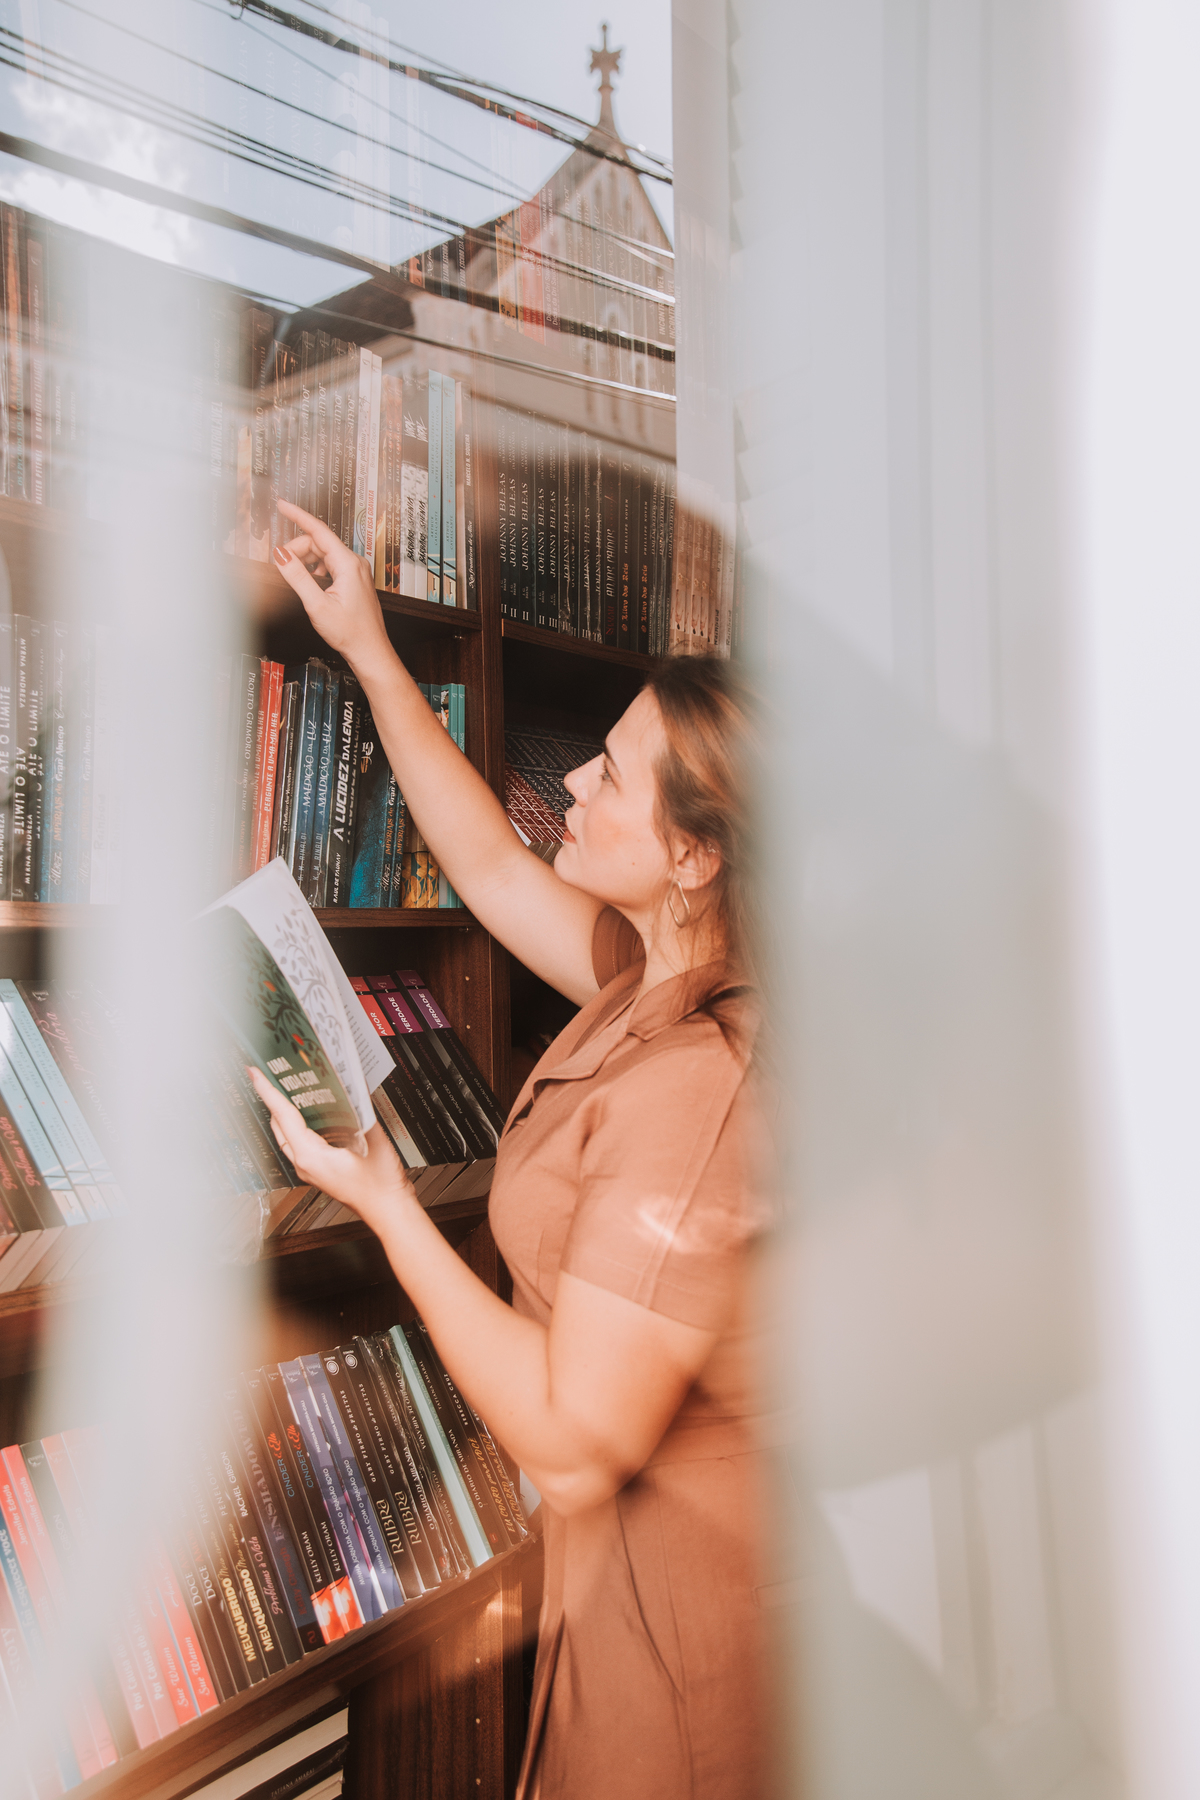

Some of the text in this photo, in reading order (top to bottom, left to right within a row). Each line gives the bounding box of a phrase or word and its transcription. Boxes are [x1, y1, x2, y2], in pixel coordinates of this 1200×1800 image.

[301, 383, 310, 420] amor
[318, 382, 326, 417] amor
[299, 478, 306, 489] O
[317, 475, 325, 485] O
[499, 515, 507, 562] JOHNNY
[509, 520, 517, 567] JOHNNY
[521, 482, 529, 571] JOHNNY BLEAS
[537, 487, 545, 575] JOHNNY BLEAS
[307, 719, 318, 741] LUZ
[308, 743, 313, 752] DA
[322, 721, 332, 743] LUZ
[323, 744, 329, 754] DA
[15, 746, 28, 835] ATÉ O LIMITE
[265, 772, 273, 812] PERGUNTE
[302, 754, 314, 807] MALDIÇÃO
[317, 756, 329, 808] MALDIÇÃO
[335, 760, 349, 823] LUCIDEZ
[333, 826, 344, 842] A
[334, 878, 339, 886] DE
[370, 1011, 388, 1037] AMOR
[387, 994, 414, 1033] VERDADE
[417, 990, 445, 1029] VERDADE
[266, 1056, 293, 1075] UMA
[278, 1074, 304, 1092] VIDA
[473, 1076, 482, 1089] CEO
[414, 1087, 424, 1099] CEO
[442, 1082, 452, 1095] CEO
[451, 1393, 469, 1426] REBECCA
[265, 1429, 284, 1453] Ella
[284, 1421, 303, 1445] Ella
[339, 1389, 377, 1483] GABY FIRMO FREITAS
[357, 1382, 396, 1475] GABY FIRMO FREITAS
[447, 1428, 466, 1463] MIRANDA
[219, 1450, 250, 1517] RACHEL GIBSON
[228, 1408, 288, 1544] ENSHADOWED
[276, 1457, 296, 1498] CINDER
[295, 1448, 316, 1489] CINDER
[18, 1475, 46, 1538] Jennifer Echols
[204, 1464, 229, 1516] PENELOPE
[326, 1484, 342, 1512] DRAGÃO
[348, 1475, 364, 1503] DRAGÃO
[1, 1483, 29, 1547] Jennifer Echols
[338, 1517, 350, 1535] COM
[360, 1508, 371, 1525] COM
[503, 1517, 516, 1535] EU
[319, 1520, 342, 1572] KELLY ORAM
[343, 1533, 360, 1564] JORNADA
[365, 1524, 382, 1554] JORNADA
[299, 1530, 324, 1584] KELLY ORAM
[197, 1564, 217, 1600] DOCE
[257, 1568, 284, 1617] Problemas
[140, 1649, 159, 1680] Causa
[150, 1680, 165, 1700] Por
